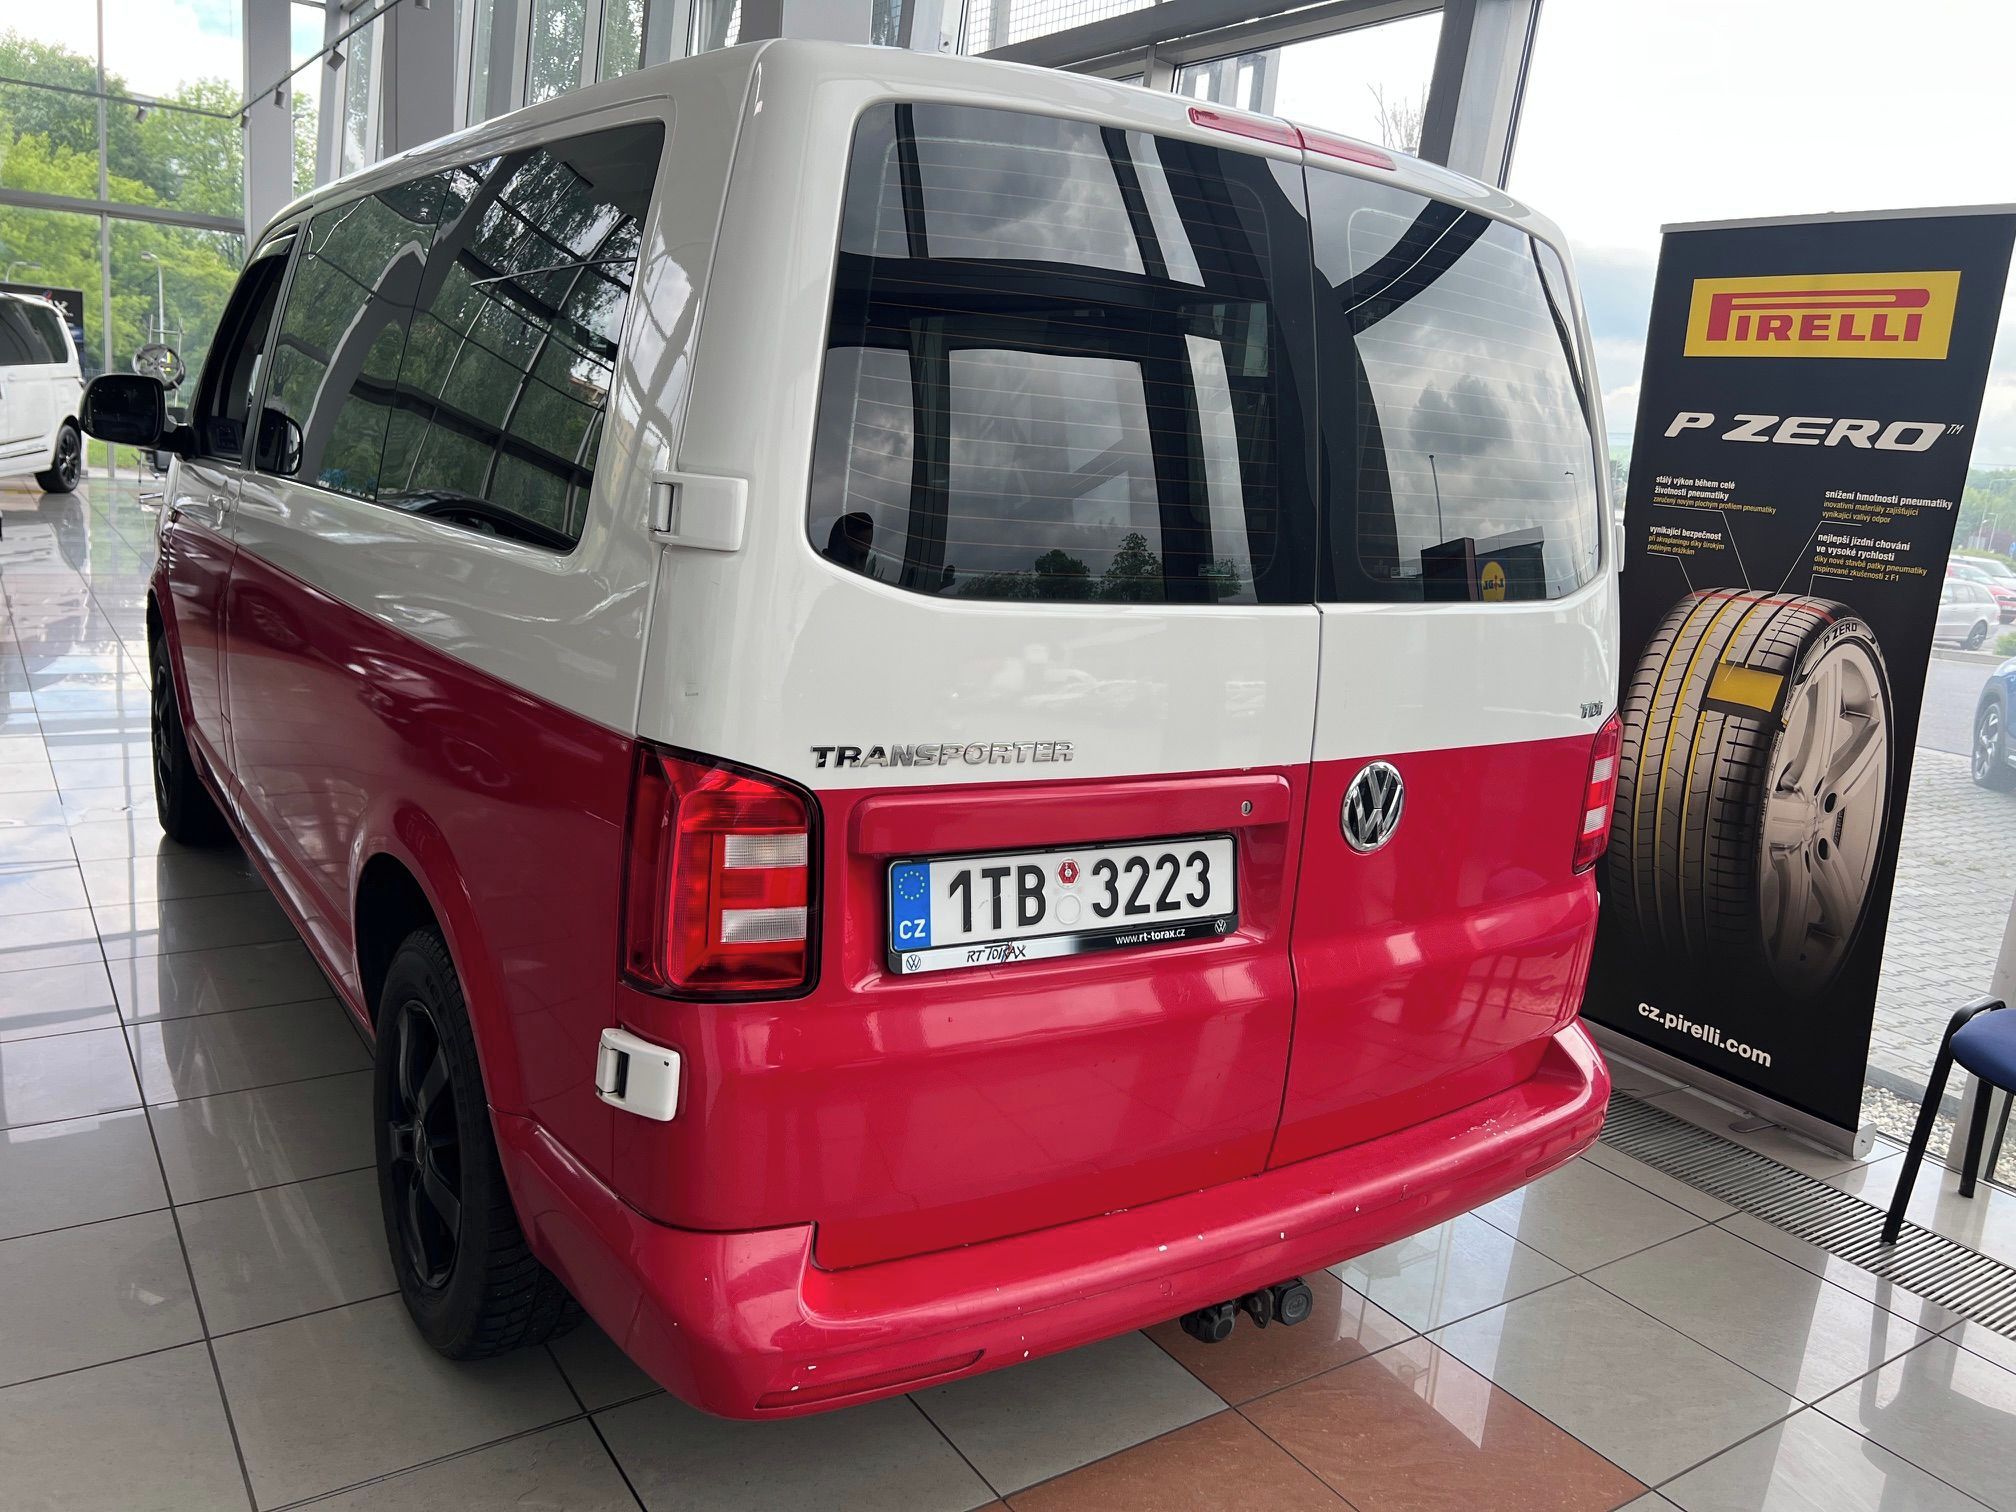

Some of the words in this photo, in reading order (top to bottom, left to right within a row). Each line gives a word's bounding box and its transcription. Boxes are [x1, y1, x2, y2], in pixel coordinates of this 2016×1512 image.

[1706, 288, 1930, 342] PIRELLI
[1664, 411, 1715, 438] P
[1721, 414, 1947, 452] ZERO
[1656, 476, 1672, 484] stálý
[1674, 477, 1694, 486] výkon
[1695, 478, 1718, 488] během
[1720, 481, 1736, 490] celé
[1655, 486, 1686, 496] životnosti
[1688, 490, 1730, 501] pneumatiky
[1825, 490, 1854, 500] snížení
[1856, 492, 1899, 504] hmotnosti
[1900, 497, 1953, 511] pneumatiky
[1695, 500, 1718, 508] plochým
[1719, 502, 1742, 511] profilem
[1742, 505, 1776, 515] pneumatiky
[1824, 500, 1854, 510] inovativní
[1855, 504, 1885, 514] materiály
[1822, 510, 1852, 520] vynikající
[1872, 516, 1892, 524] odpor
[1650, 526, 1681, 536] vynikající
[1682, 528, 1722, 540] bezpečnost
[1818, 533, 1850, 544] nejlepší
[1850, 536, 1874, 547] jízdní
[1875, 538, 1911, 551] chování
[1828, 546, 1856, 558] vysoké
[1858, 550, 1895, 562] rychlosti
[1813, 565, 1849, 576] inspirované
[1850, 568, 1884, 580] zkušenosti
[1890, 573, 1899, 582] F1
[1828, 557, 1844, 565] nové
[1867, 562, 1885, 572] patky
[1886, 564, 1928, 576] pneumatiky
[1823, 634, 1830, 650] P
[1832, 622, 1858, 641] ZERO
[810, 741, 1074, 769] TRANSPORTER
[949, 864, 1047, 933] 1TB
[1091, 850, 1211, 919] 3223
[899, 919, 926, 940] CZ
[1115, 928, 1186, 945] www.rt-torax.cz
[966, 949, 985, 963] RT
[984, 941, 1027, 963] TORAX
[1637, 1002, 1772, 1068] cz.pirelli.com
